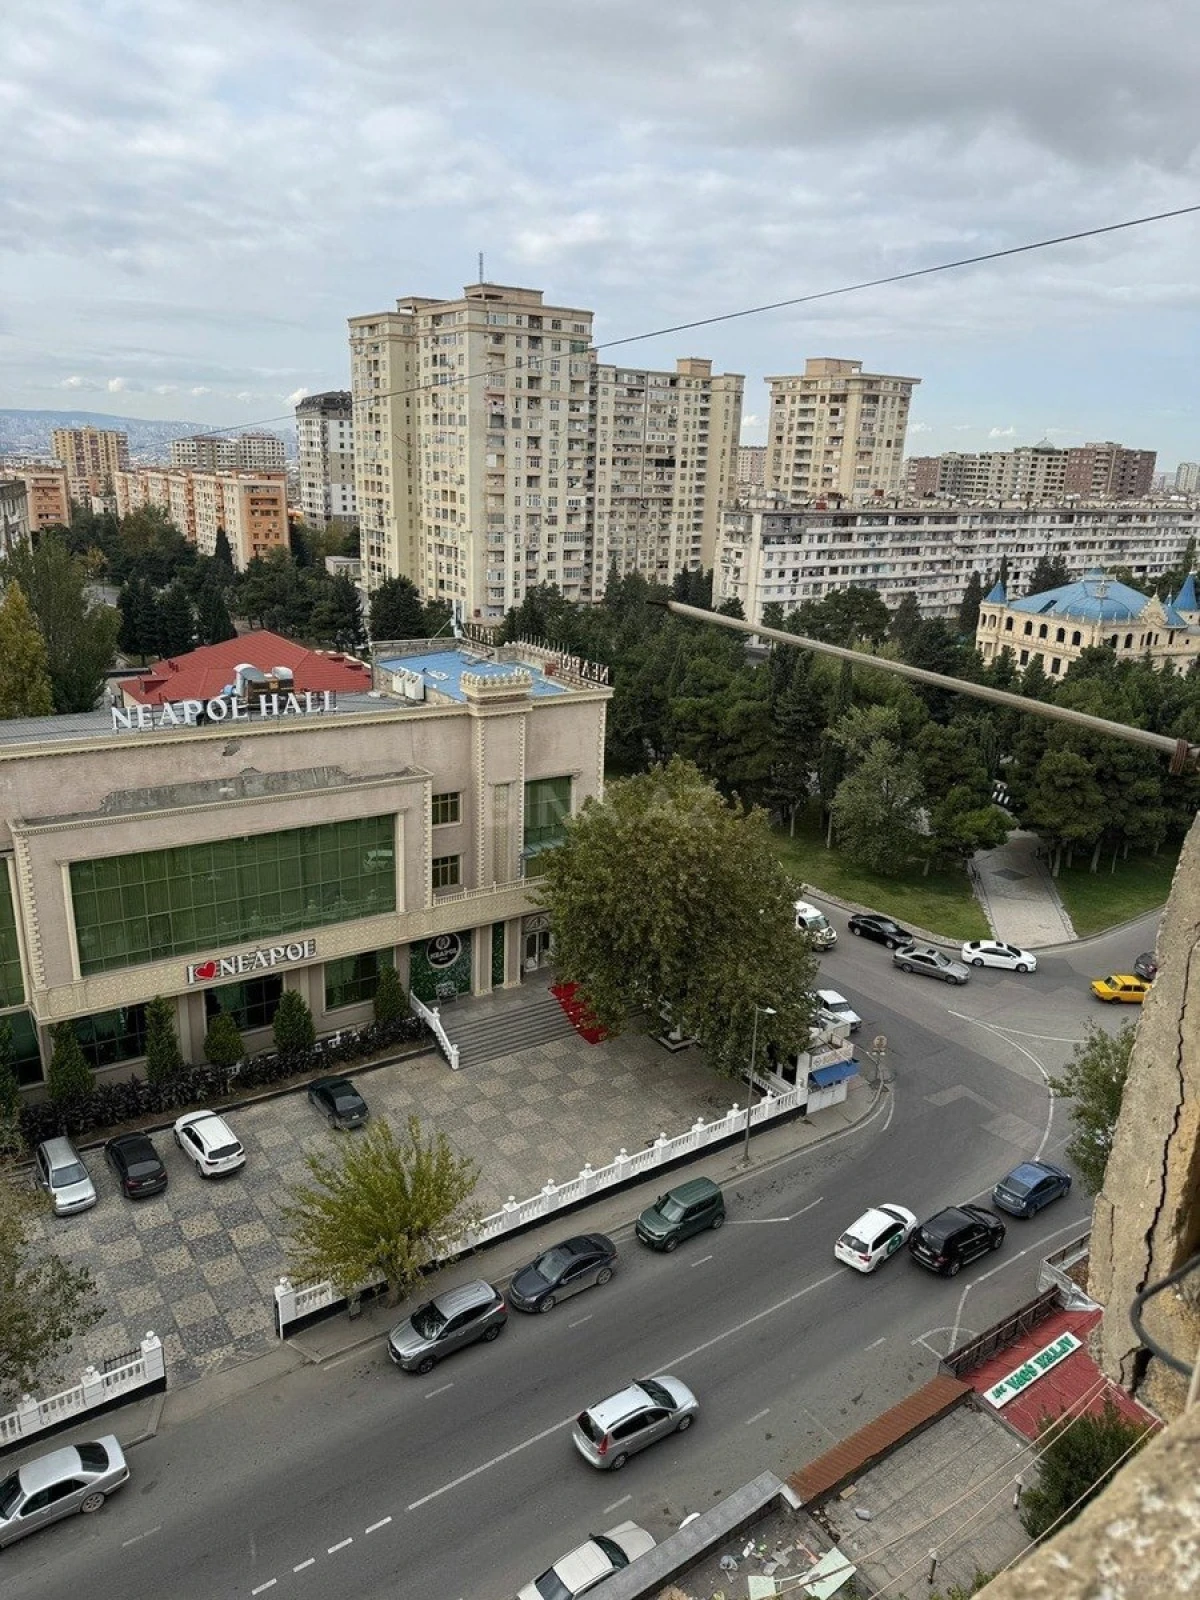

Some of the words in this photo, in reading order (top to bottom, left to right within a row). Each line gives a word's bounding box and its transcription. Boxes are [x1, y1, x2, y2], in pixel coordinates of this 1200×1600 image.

[111, 697, 248, 730] NEAPOL
[260, 690, 338, 717] HALL
[220, 939, 317, 977] NEAPOL
